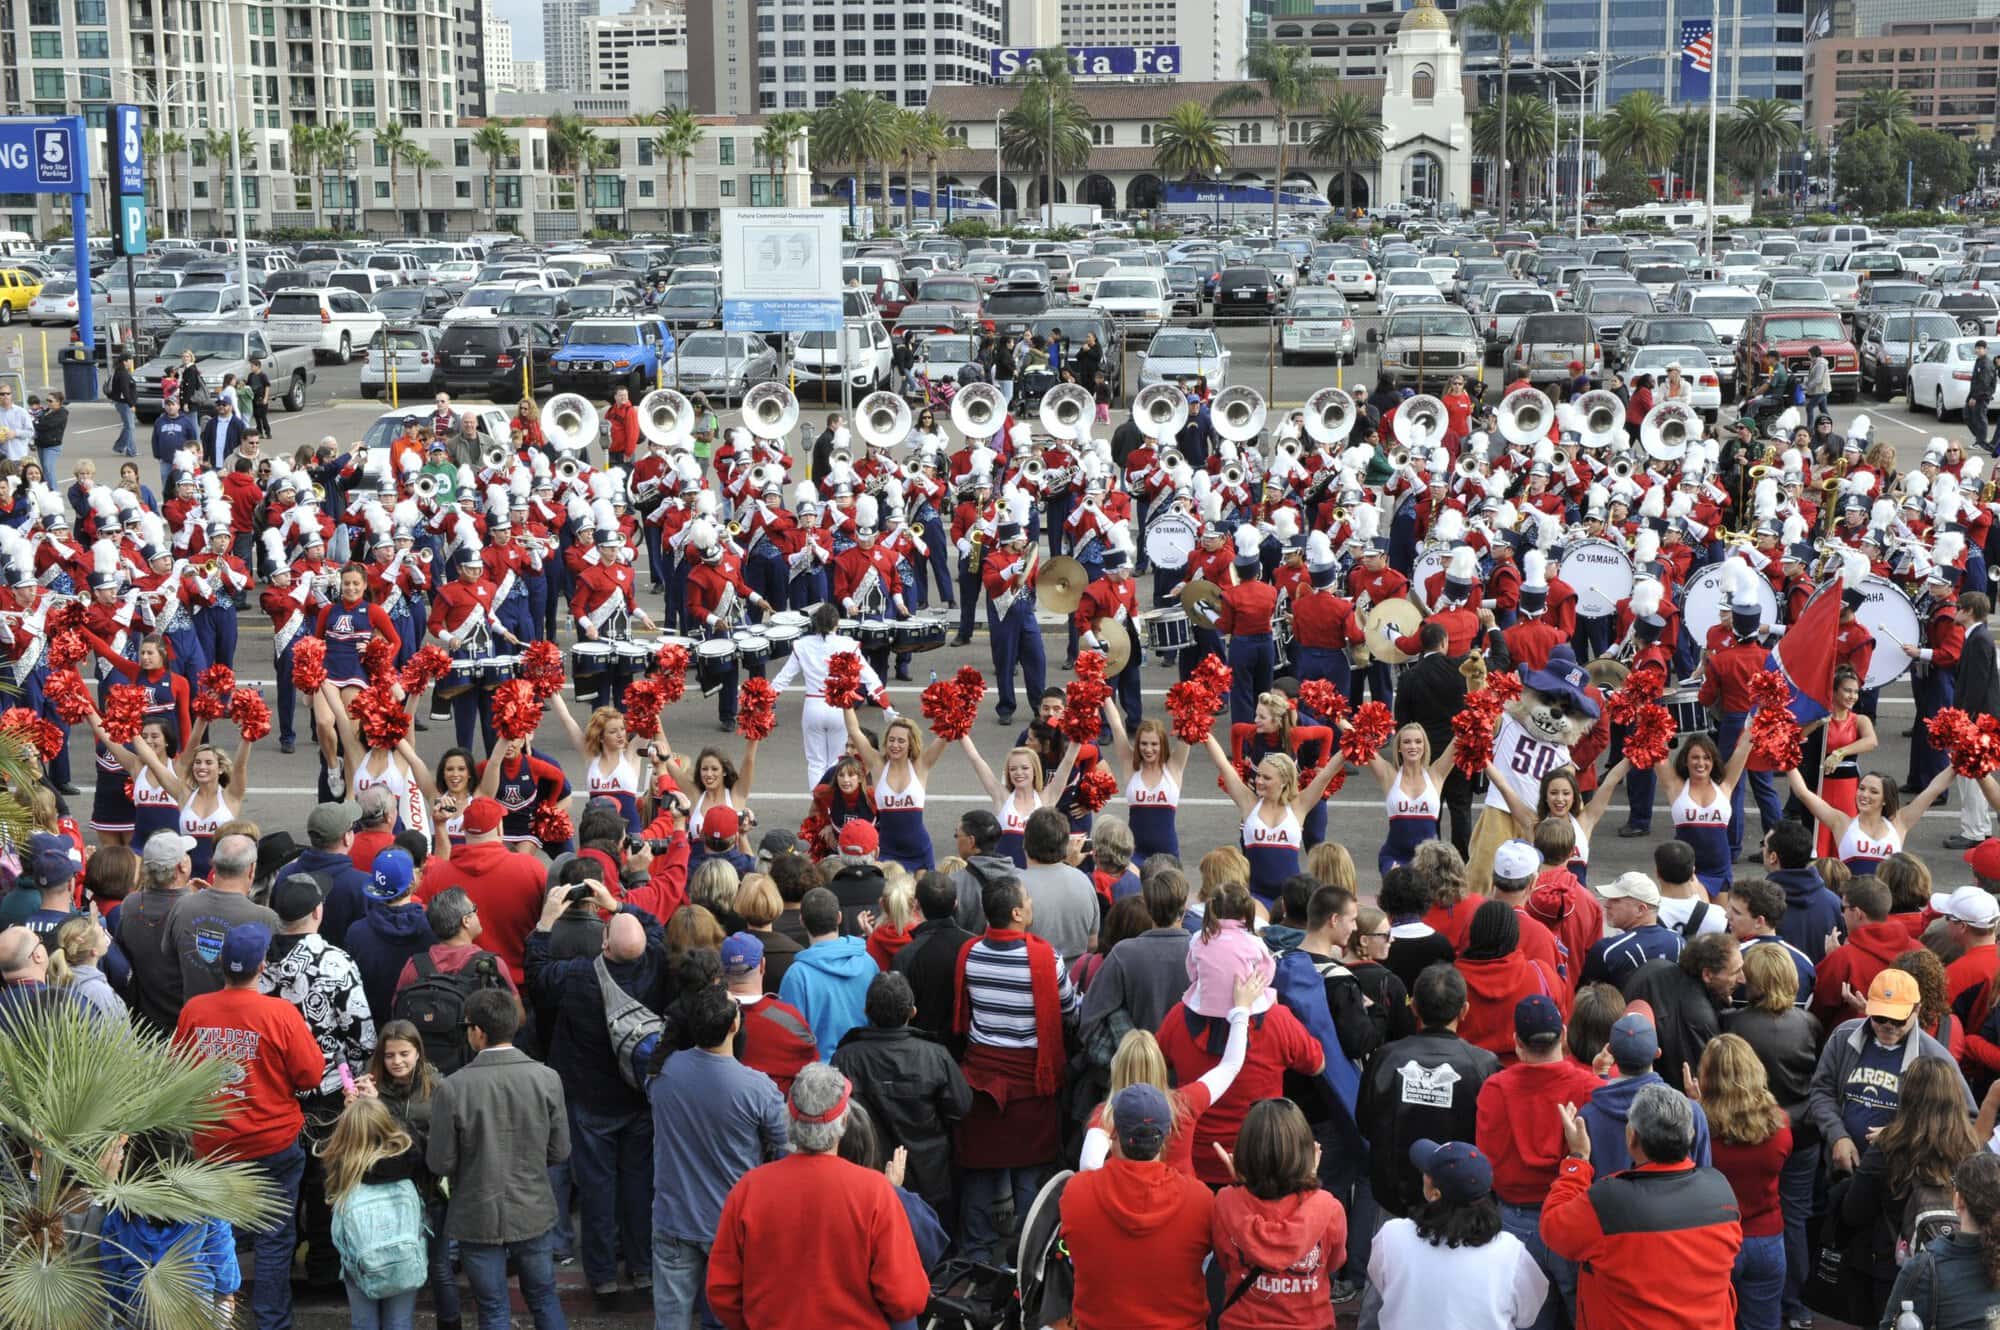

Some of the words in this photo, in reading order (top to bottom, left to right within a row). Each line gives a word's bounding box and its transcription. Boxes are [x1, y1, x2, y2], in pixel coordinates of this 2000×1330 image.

[998, 49, 1112, 75] Sata
[1133, 47, 1174, 74] Fe
[124, 110, 139, 164] 5
[43, 132, 64, 163] 5
[41, 170, 67, 178] Parking
[123, 165, 132, 175] Five
[132, 166, 141, 175] Star
[124, 178, 141, 188] Parking
[128, 206, 142, 245] P
[1585, 554, 1619, 566] YAMAHA
[1511, 734, 1557, 781] 50
[591, 778, 600, 789] U
[611, 778, 621, 788] A
[139, 790, 149, 801] U
[159, 791, 169, 802] A
[885, 796, 894, 807] U
[904, 795, 915, 806] A
[1135, 790, 1146, 802] U
[1156, 791, 1167, 802] A
[1398, 801, 1408, 812] U
[1419, 801, 1429, 812] A
[1007, 814, 1017, 827] U
[1685, 809, 1696, 822] U
[1711, 809, 1722, 821] A
[186, 820, 197, 832] U
[208, 821, 218, 832] A
[1254, 829, 1265, 841] U
[1277, 830, 1288, 842] A
[1857, 840, 1868, 854] U
[1883, 843, 1894, 855] A
[375, 870, 386, 885] KC
[194, 1026, 261, 1046] WILDCAT
[226, 1045, 257, 1060] LIFE
[1241, 1274, 1319, 1294] ILDCATS
